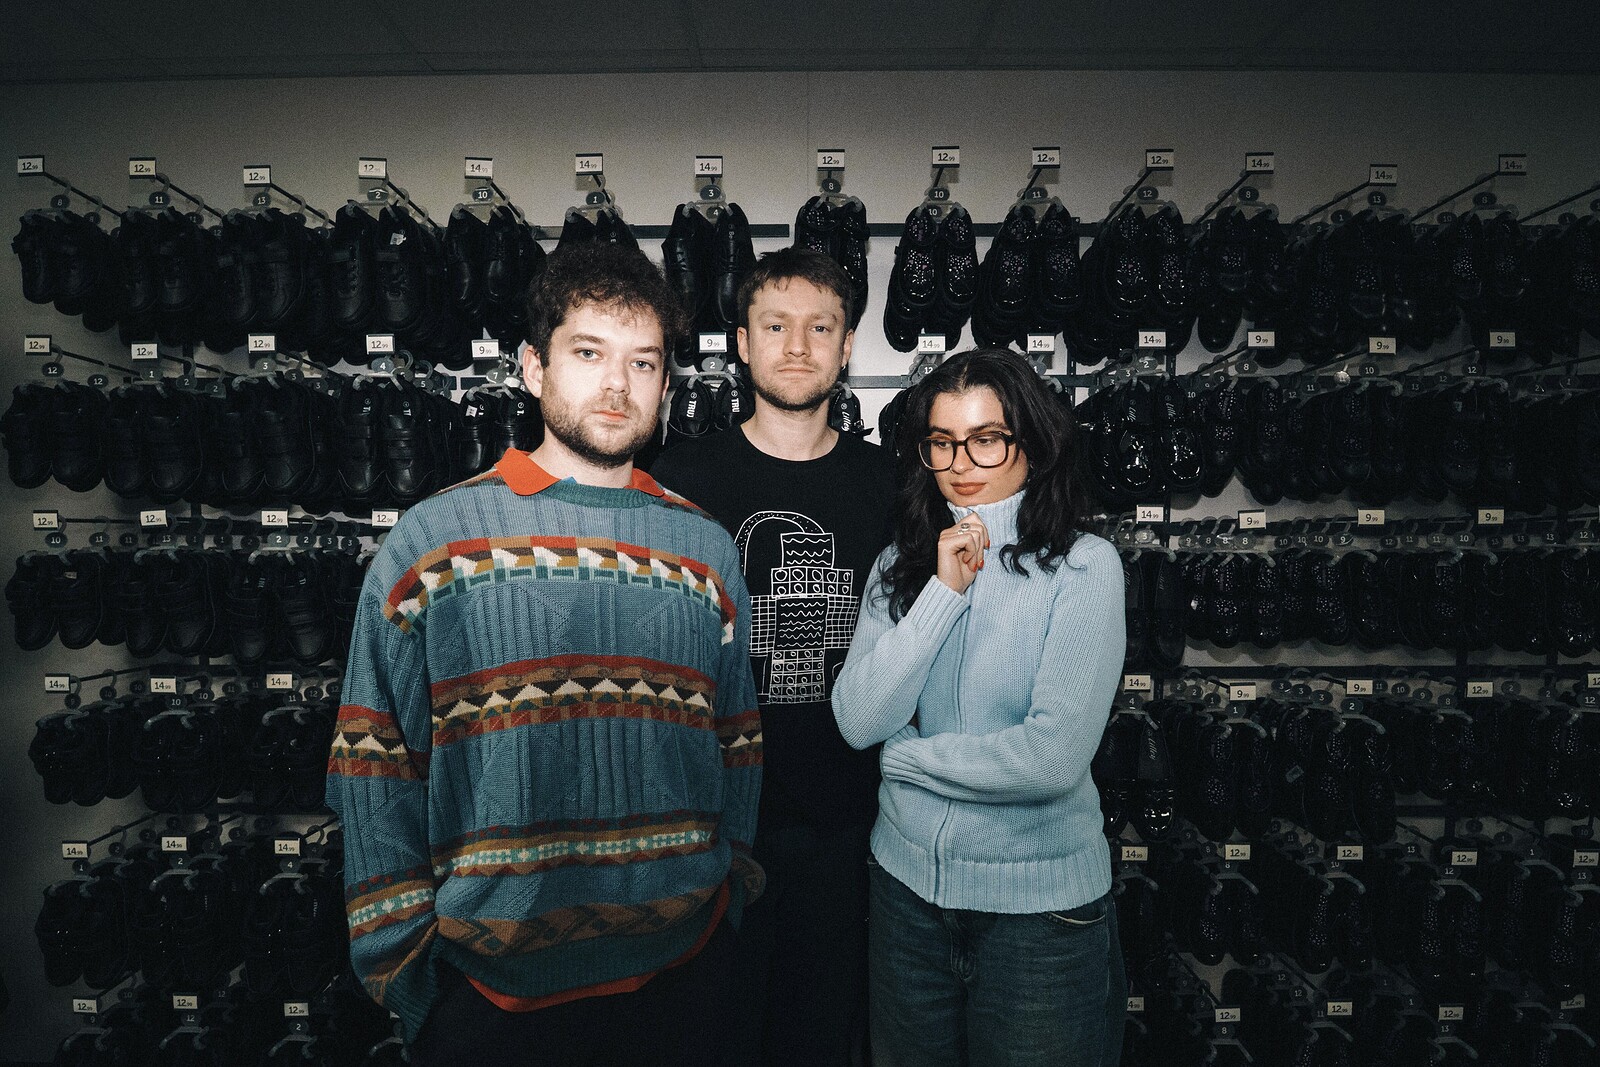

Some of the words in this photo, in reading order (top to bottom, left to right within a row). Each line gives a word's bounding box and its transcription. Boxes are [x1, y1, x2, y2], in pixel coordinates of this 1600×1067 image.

[1468, 366, 1477, 374] 12
[493, 372, 499, 380] 7
[420, 380, 426, 388] 5
[841, 411, 852, 432] Lilley
[1579, 531, 1588, 539] 12
[347, 539, 353, 547] 3
[1242, 537, 1248, 545] 8
[1298, 687, 1304, 695] 3
[1319, 693, 1325, 701] 3
[1584, 696, 1595, 704] 12
[171, 698, 181, 706] 10
[1233, 706, 1238, 714] 1
[1444, 867, 1454, 875] 12
